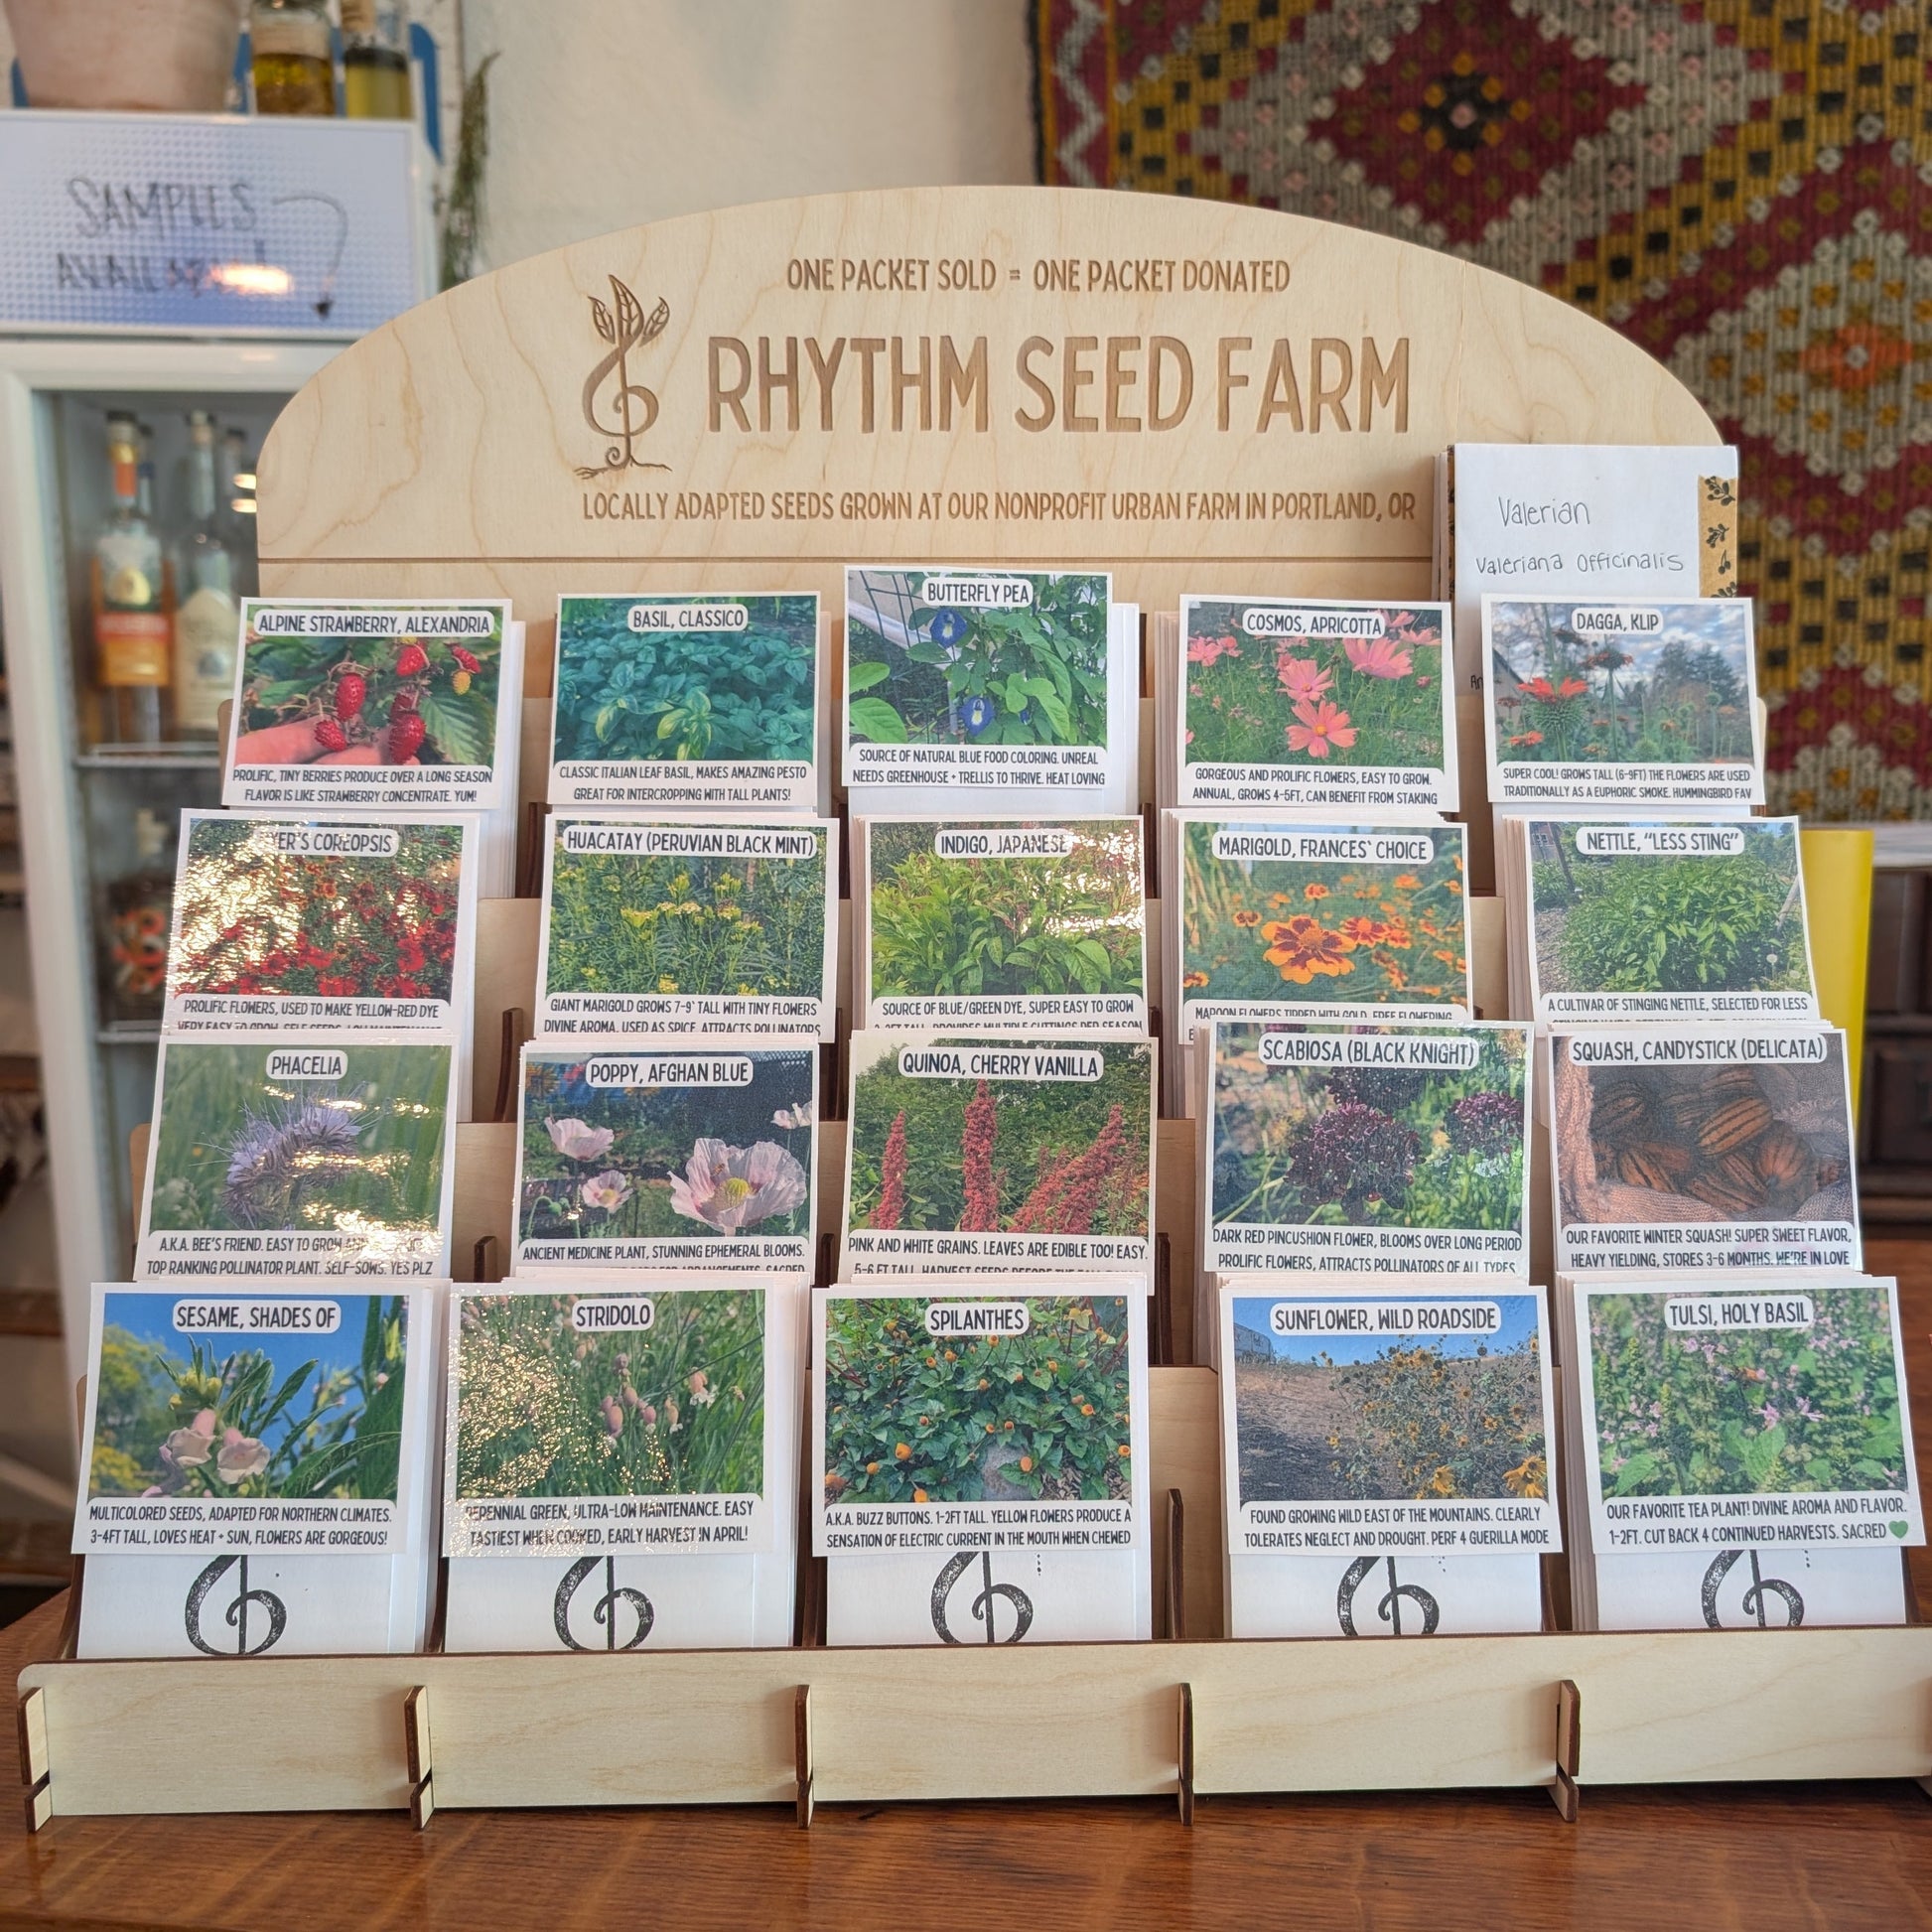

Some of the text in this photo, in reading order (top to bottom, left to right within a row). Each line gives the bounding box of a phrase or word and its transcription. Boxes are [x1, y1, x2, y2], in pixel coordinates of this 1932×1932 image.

[68, 178, 258, 240] SAMPLES
[786, 258, 834, 291] ONE
[841, 258, 930, 291] PACKET
[937, 258, 997, 291] SOLD
[1034, 258, 1080, 292] ONE
[1087, 258, 1176, 292] PACKET
[1182, 259, 1290, 293] DONATED
[708, 335, 1410, 434] RHYTHM SEED FARM
[583, 491, 1416, 523] LOCALLY ADAPTED SEEDS GROWN AT OUR NONPROFIT URBAN FARM IN PORTLAND, OR
[1498, 496, 1590, 527] Valerian
[1475, 554, 1564, 576] Valeriana
[927, 583, 1029, 603] BUTTERFLY PEA
[258, 615, 491, 635] ALPINE STRAWBERRY, ALEXANDRIA
[633, 610, 744, 628] BASIL, CLASSICO
[1247, 614, 1383, 636] COSMOS, APRICOTTA
[1577, 613, 1659, 631] DAGGA, KLIP
[559, 765, 806, 779] CLASSIC ITALIAN LEAF BASIL, MAKES AMAZING PESTO
[1195, 767, 1432, 785] GORGEOUS AND PROLIFIC FLOWERS, EASY TO GROW.
[244, 788, 477, 802] FLAVOR IS LIKE STRAWBERRY CONCENTRATE. YUM!
[313, 833, 392, 853] COREOPSIS
[567, 831, 816, 857] HUACATAY (PERUVIAN BLACK MINT)
[941, 834, 1067, 855] INDIGO, JAPANESE
[1219, 836, 1296, 858] MARIGOLD,
[1375, 840, 1427, 860] CHOICE
[1587, 832, 1641, 852] NETTLE,
[184, 999, 439, 1018] PROLIFIC FLOWERS, USED TO MAKE YELLOW-RED DYE
[882, 999, 1134, 1016] SOURCE OF BLUE/GREEN DYE, SUPER EASY TO GROW
[1263, 1038, 1477, 1067] SCABIOSA (BLACK KNIGHT)
[1573, 1037, 1823, 1061] SQUASH, CANDYSTICK (DELICATA)
[271, 1055, 342, 1075] PHACELIA
[589, 1062, 748, 1086] POPPY, AFGHAN BLUE
[902, 1052, 1098, 1076] QUINOA, CHERRY VANILLA
[848, 1237, 1149, 1260] PINK AND WHITE GRAINS. LEAVES ARE EDIBLE TOO! EASY.
[1211, 1227, 1522, 1251] DARK RED PINCUSHION FLOWER, BLOOMS OVER LONG PERIOD
[175, 1306, 336, 1330] SESAME, SHADES OF
[576, 1304, 650, 1326] STRIDOLO
[930, 1309, 1024, 1330] SPILANTHES
[1275, 1308, 1496, 1331] SUNFLOWER, WILD ROADSIDE
[1669, 1302, 1809, 1326] TULSI, HOLY BASIL
[89, 1505, 391, 1522] MULTICOLORED SEEDS, ADAPTED FOR NORTHERN CLIMATES.
[1250, 1506, 1540, 1524] FOUND GROWING WILD EAST OF THE MOUNTAINS. CLEARLY
[826, 1530, 1131, 1548] SENSATION OF ELECTRIC CURRENT IN THE MOUTH WHEN CHEWED
